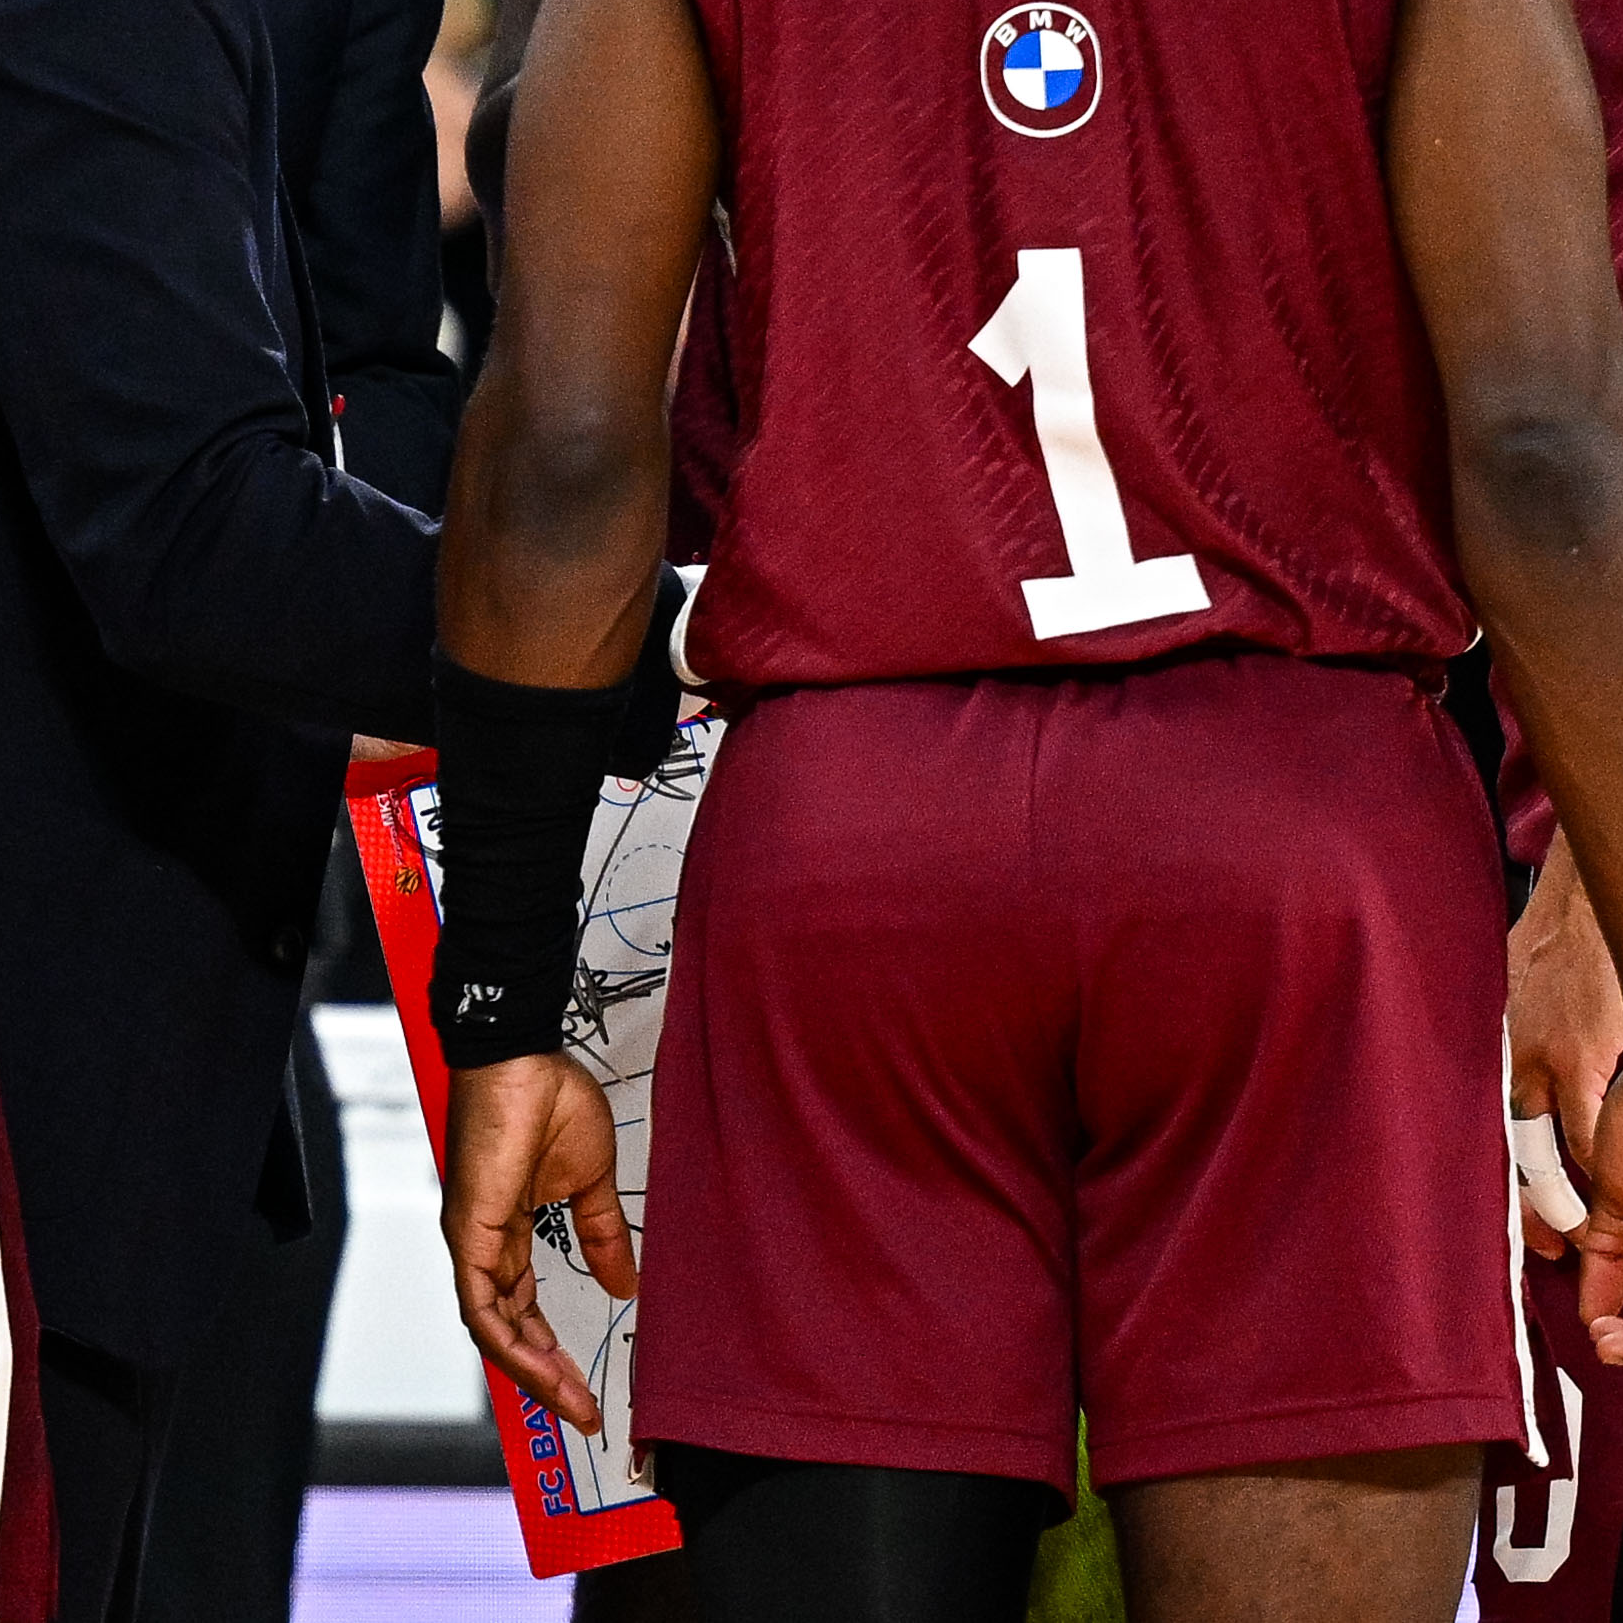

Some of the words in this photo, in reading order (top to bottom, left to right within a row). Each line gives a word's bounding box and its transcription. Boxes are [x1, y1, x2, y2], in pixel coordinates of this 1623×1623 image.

[994, 10, 1088, 48] BMW
[967, 247, 1212, 642] 1
[549, 1201, 573, 1254] adida
[538, 1466, 573, 1518] FC
